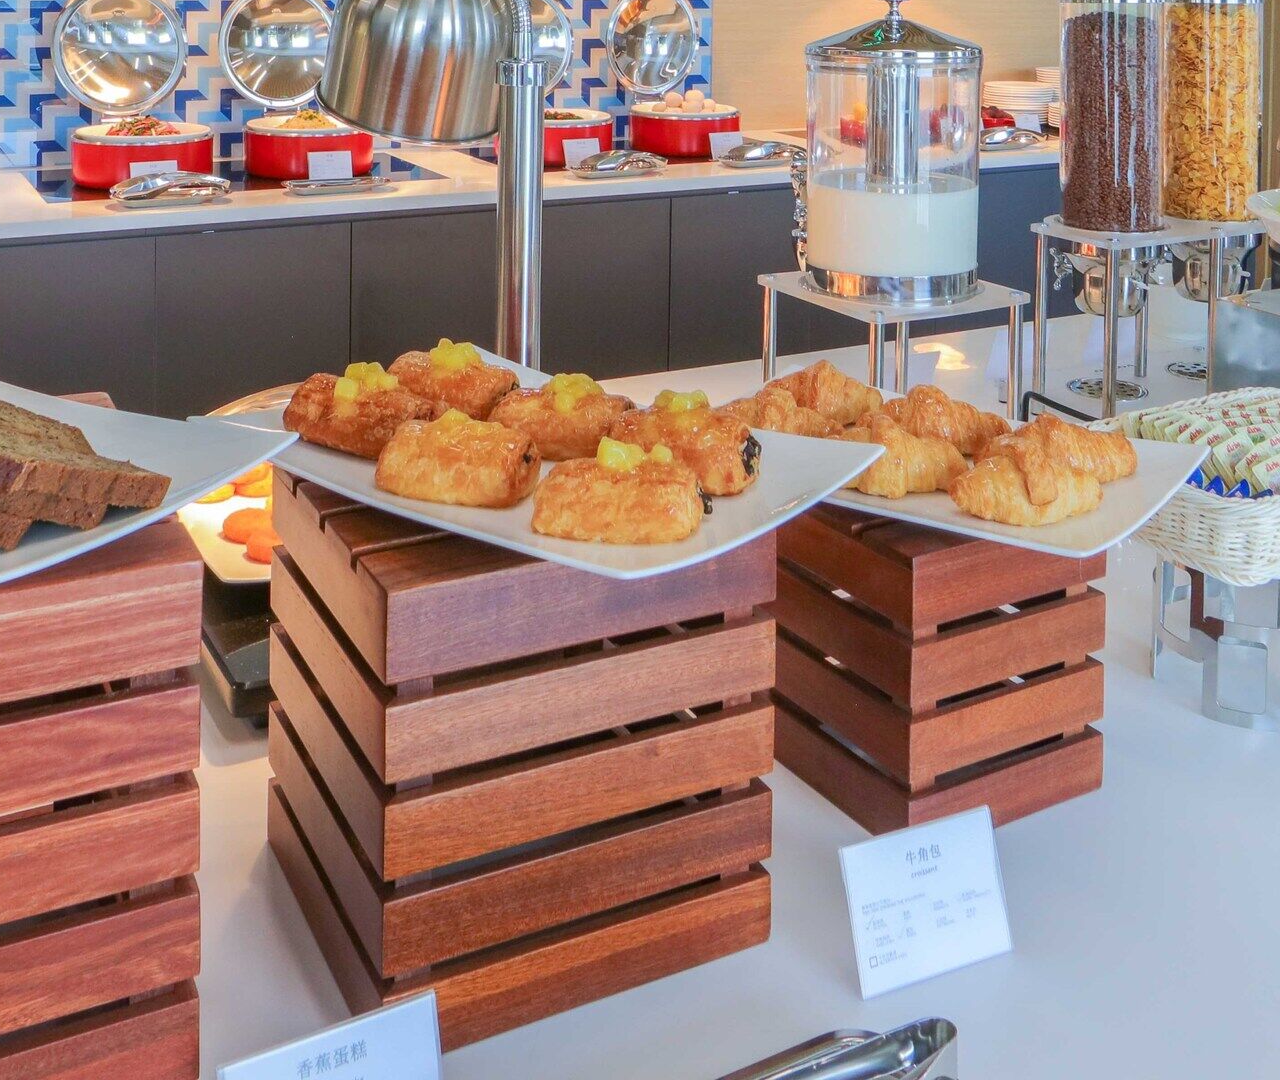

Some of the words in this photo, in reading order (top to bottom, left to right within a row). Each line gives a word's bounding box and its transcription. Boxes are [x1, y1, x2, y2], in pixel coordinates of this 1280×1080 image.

[905, 842, 942, 865] 牛角包
[297, 1038, 369, 1080] 香蕉蛋糕
